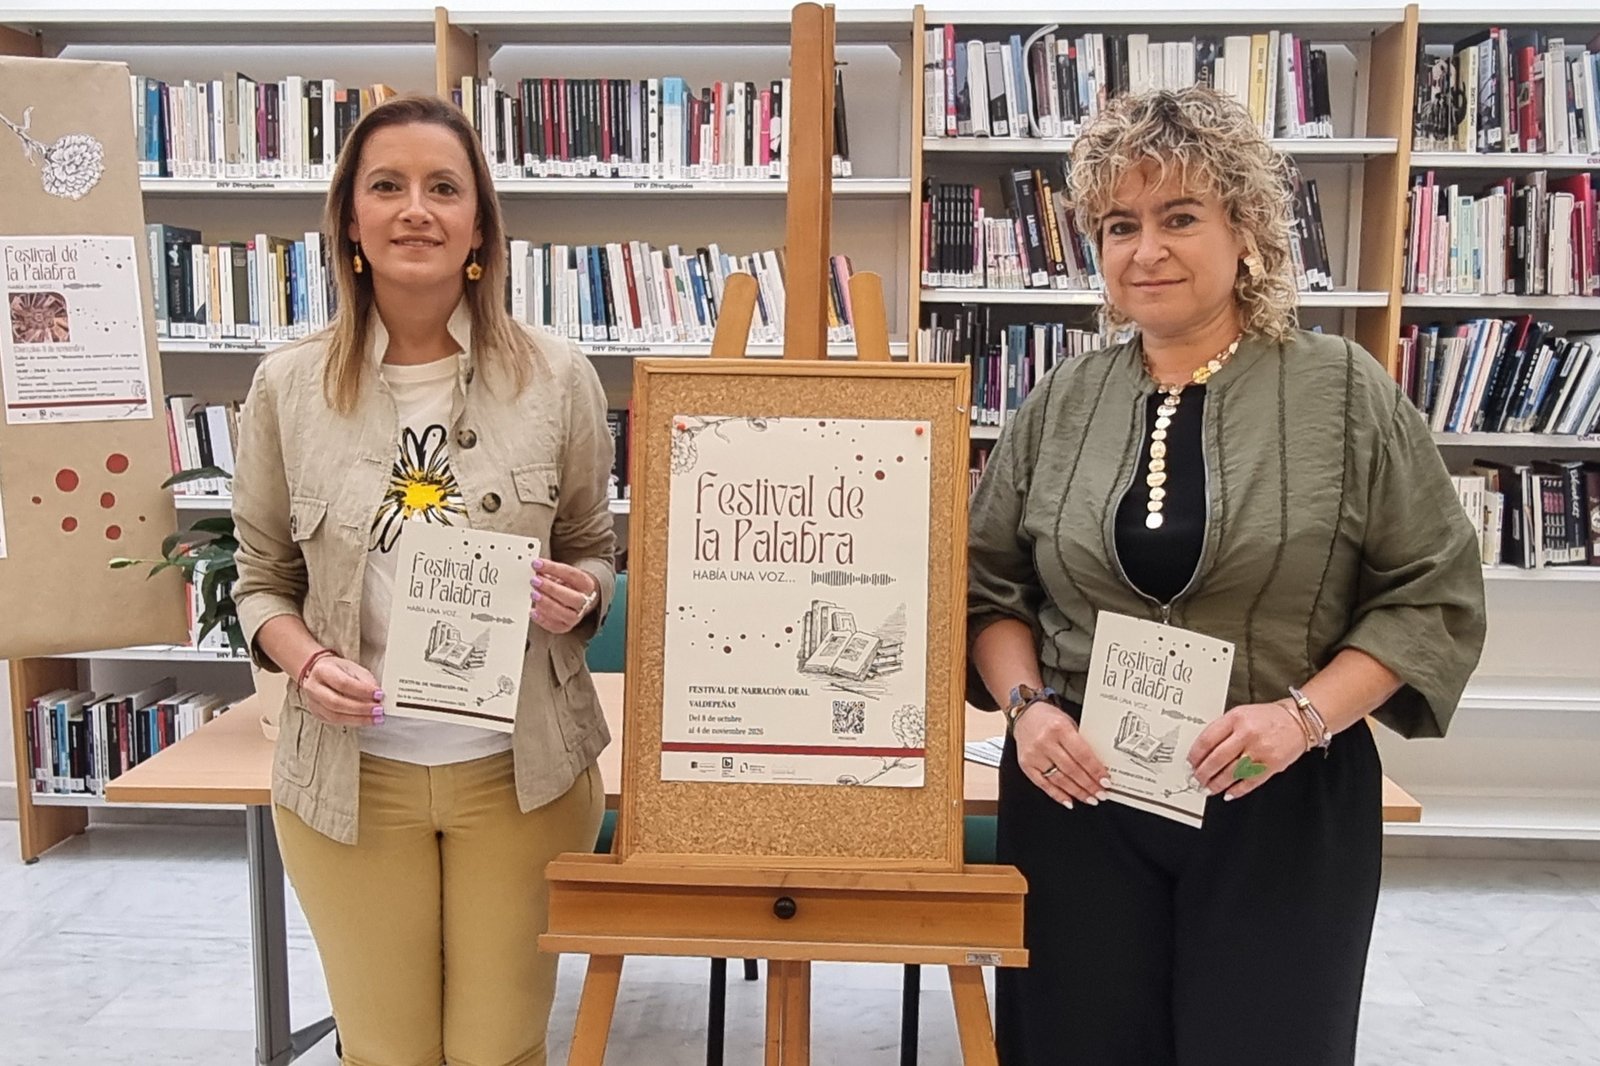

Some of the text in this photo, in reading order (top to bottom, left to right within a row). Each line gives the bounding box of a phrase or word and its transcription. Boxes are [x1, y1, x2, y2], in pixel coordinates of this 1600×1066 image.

[4, 245, 78, 263] Festival de
[6, 263, 76, 281] la Palabra
[696, 471, 864, 519] Festival de
[694, 518, 854, 564] la Palabra
[412, 551, 499, 585] Festival de
[693, 567, 727, 581] HABÍA
[731, 571, 754, 581] UNA
[409, 574, 491, 608] la Palabra
[1107, 642, 1193, 684] Festival de
[688, 685, 809, 696] FESTIVAL DE NARRACIÓN ORAL
[1103, 664, 1183, 705] la Palabra
[688, 699, 736, 708] VALDEPEÑAS
